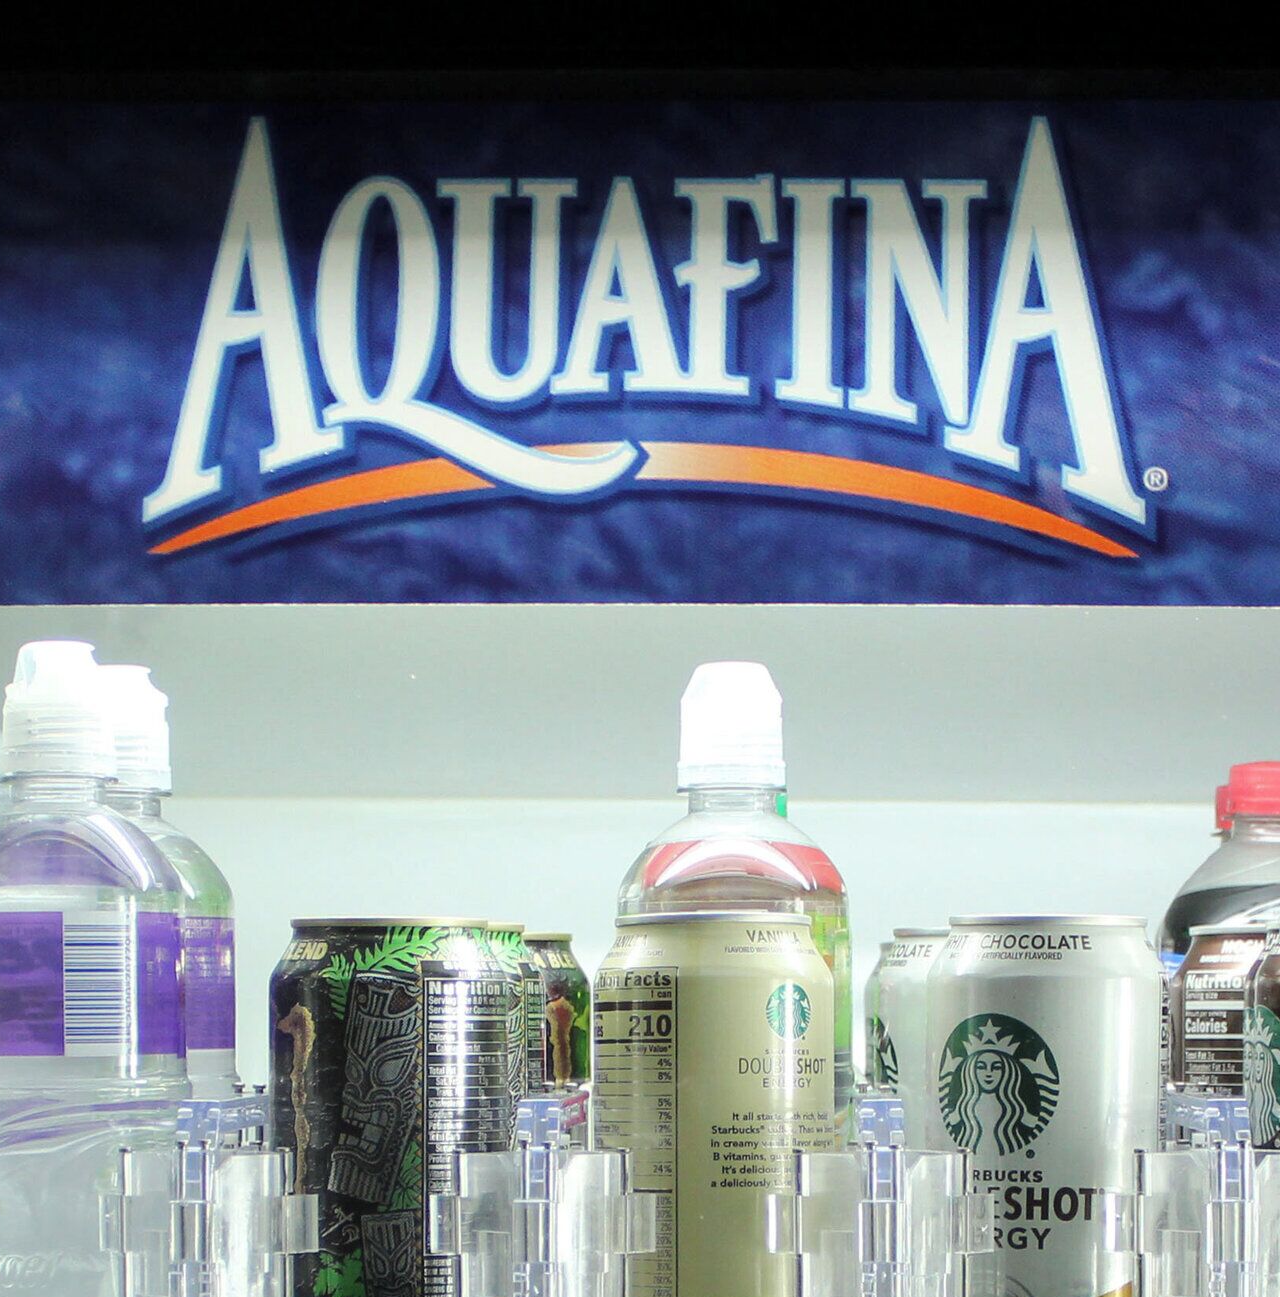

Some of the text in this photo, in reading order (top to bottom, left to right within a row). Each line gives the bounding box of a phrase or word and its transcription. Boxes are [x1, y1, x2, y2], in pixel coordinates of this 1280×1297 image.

[141, 114, 1147, 524] AQUAFINA
[980, 934, 1092, 950] CHOCOLATE
[283, 940, 329, 962] LEND
[1024, 951, 1063, 961] FLAVORED
[624, 971, 671, 987] Facts
[1186, 975, 1243, 989] Nutritio
[657, 990, 671, 999] can
[628, 1014, 671, 1038] 210
[1185, 1018, 1228, 1033] Calories
[657, 1059, 672, 1068] 4%
[739, 1057, 826, 1075] DOUBSHOT
[657, 1072, 672, 1081] 8%
[762, 1078, 811, 1088] ENGY
[732, 1112, 754, 1121] It all
[710, 1139, 759, 1150] in creamy
[713, 1152, 767, 1162] B vitamins,
[722, 1165, 736, 1175] It's
[973, 1169, 1043, 1183] RBUCKS
[720, 1179, 771, 1191] deliciously
